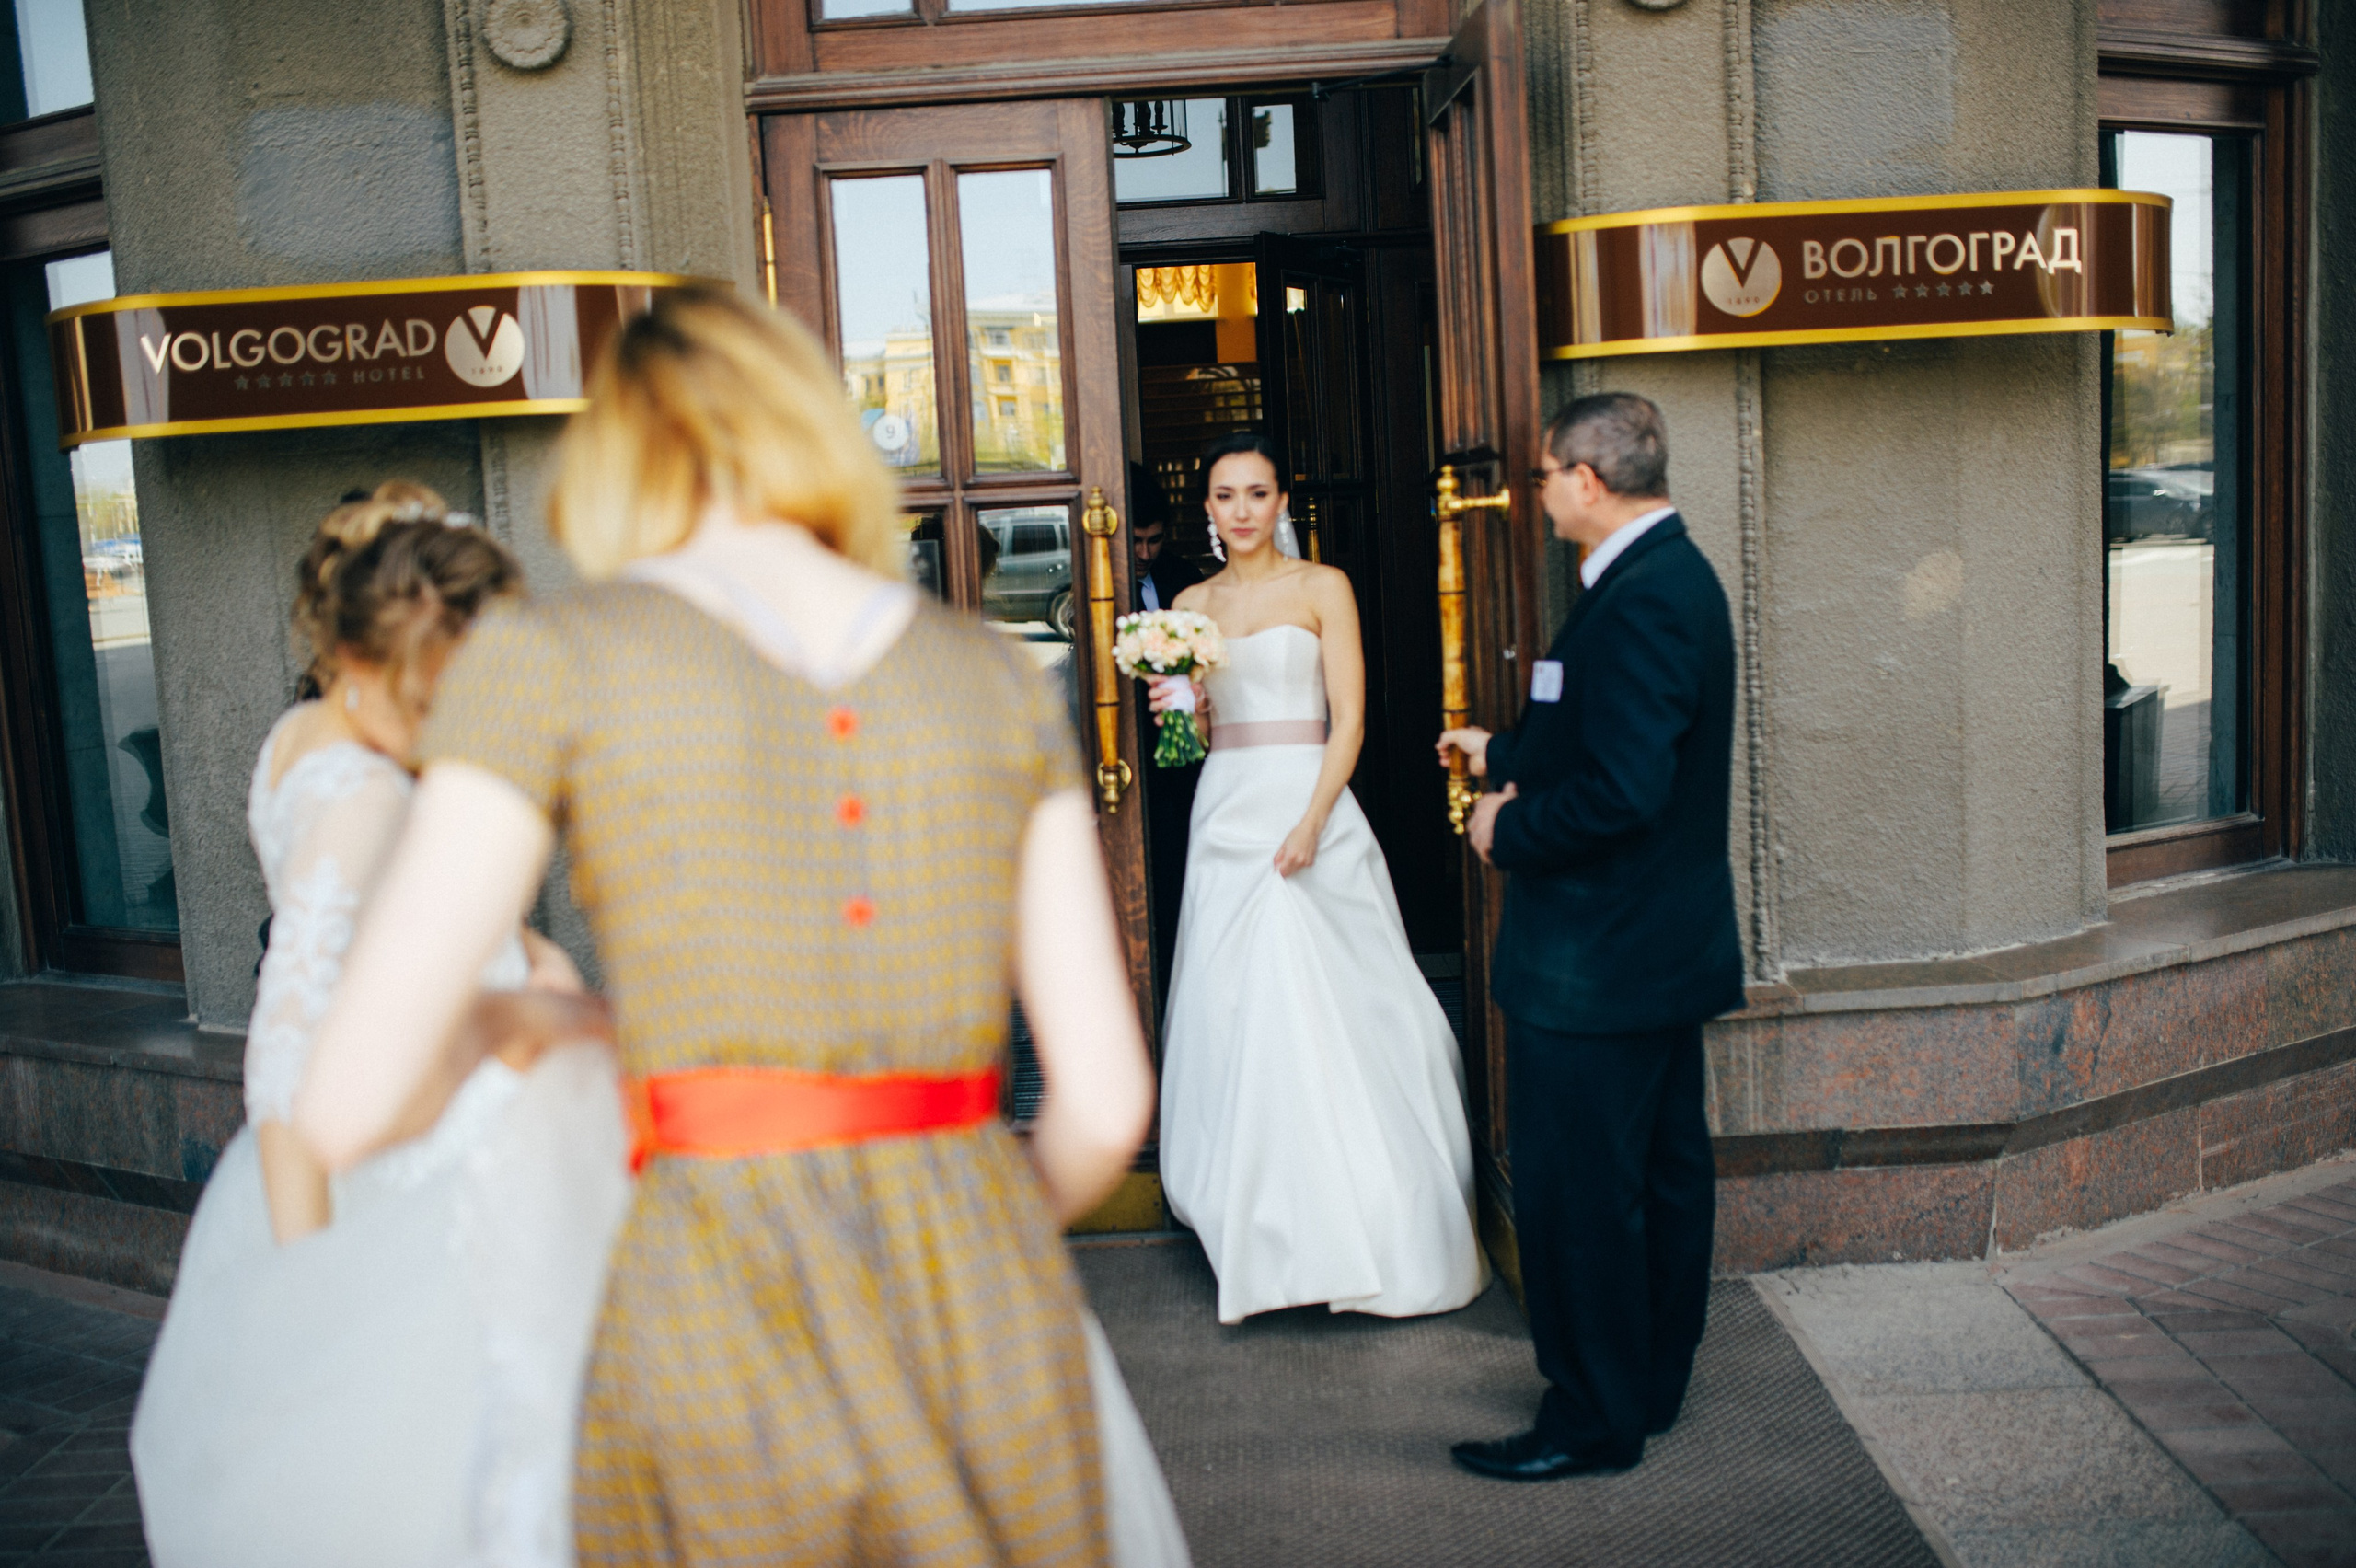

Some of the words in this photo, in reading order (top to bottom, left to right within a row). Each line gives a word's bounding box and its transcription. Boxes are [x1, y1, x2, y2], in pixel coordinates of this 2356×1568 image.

[1803, 227, 2083, 280] ВОЛГОГРАД
[1804, 287, 1877, 304] ОТЕЛЬ
[140, 318, 437, 375] VOLGOGRAD
[352, 365, 425, 384] HOTEL
